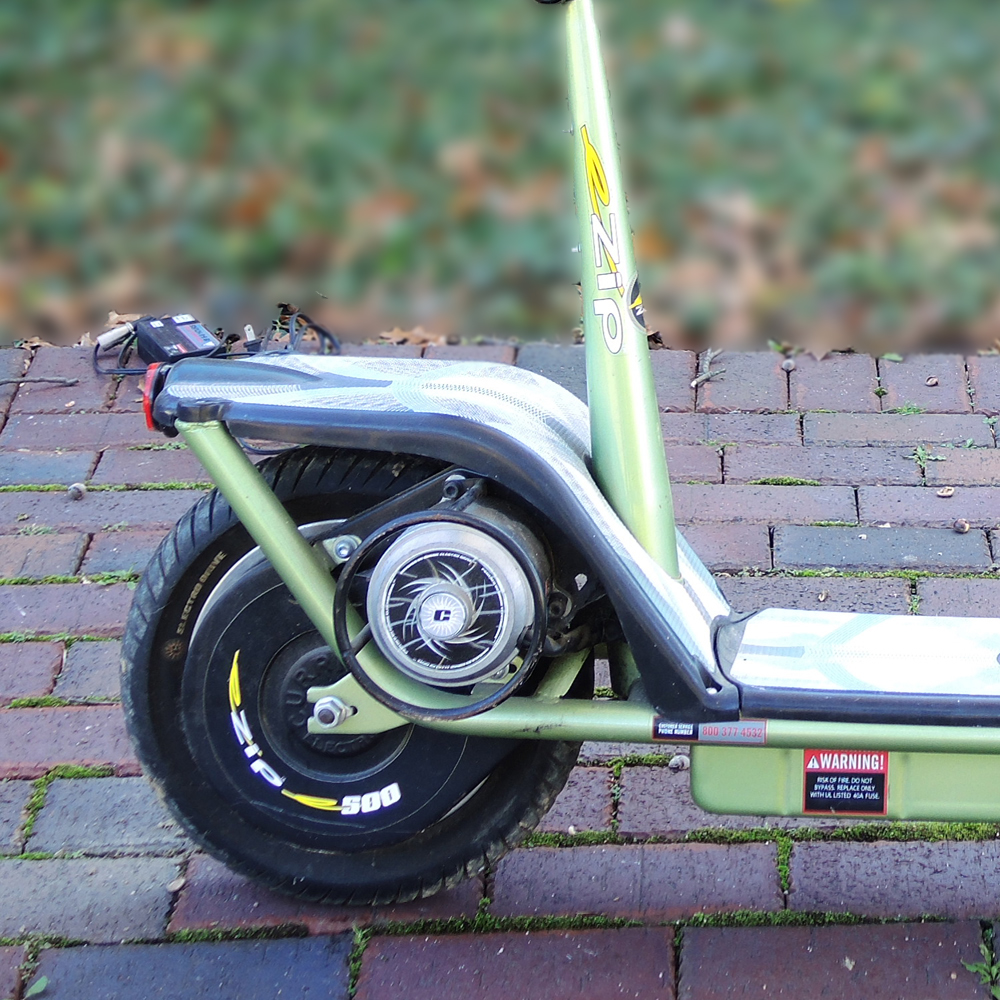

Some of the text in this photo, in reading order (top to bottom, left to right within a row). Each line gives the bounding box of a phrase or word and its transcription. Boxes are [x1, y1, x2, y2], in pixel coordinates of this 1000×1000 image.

[702, 726, 763, 738] 800 377 4532
[819, 753, 884, 770] WARNING!
[837, 784, 860, 792] REPLACE
[341, 782, 402, 815] 500
